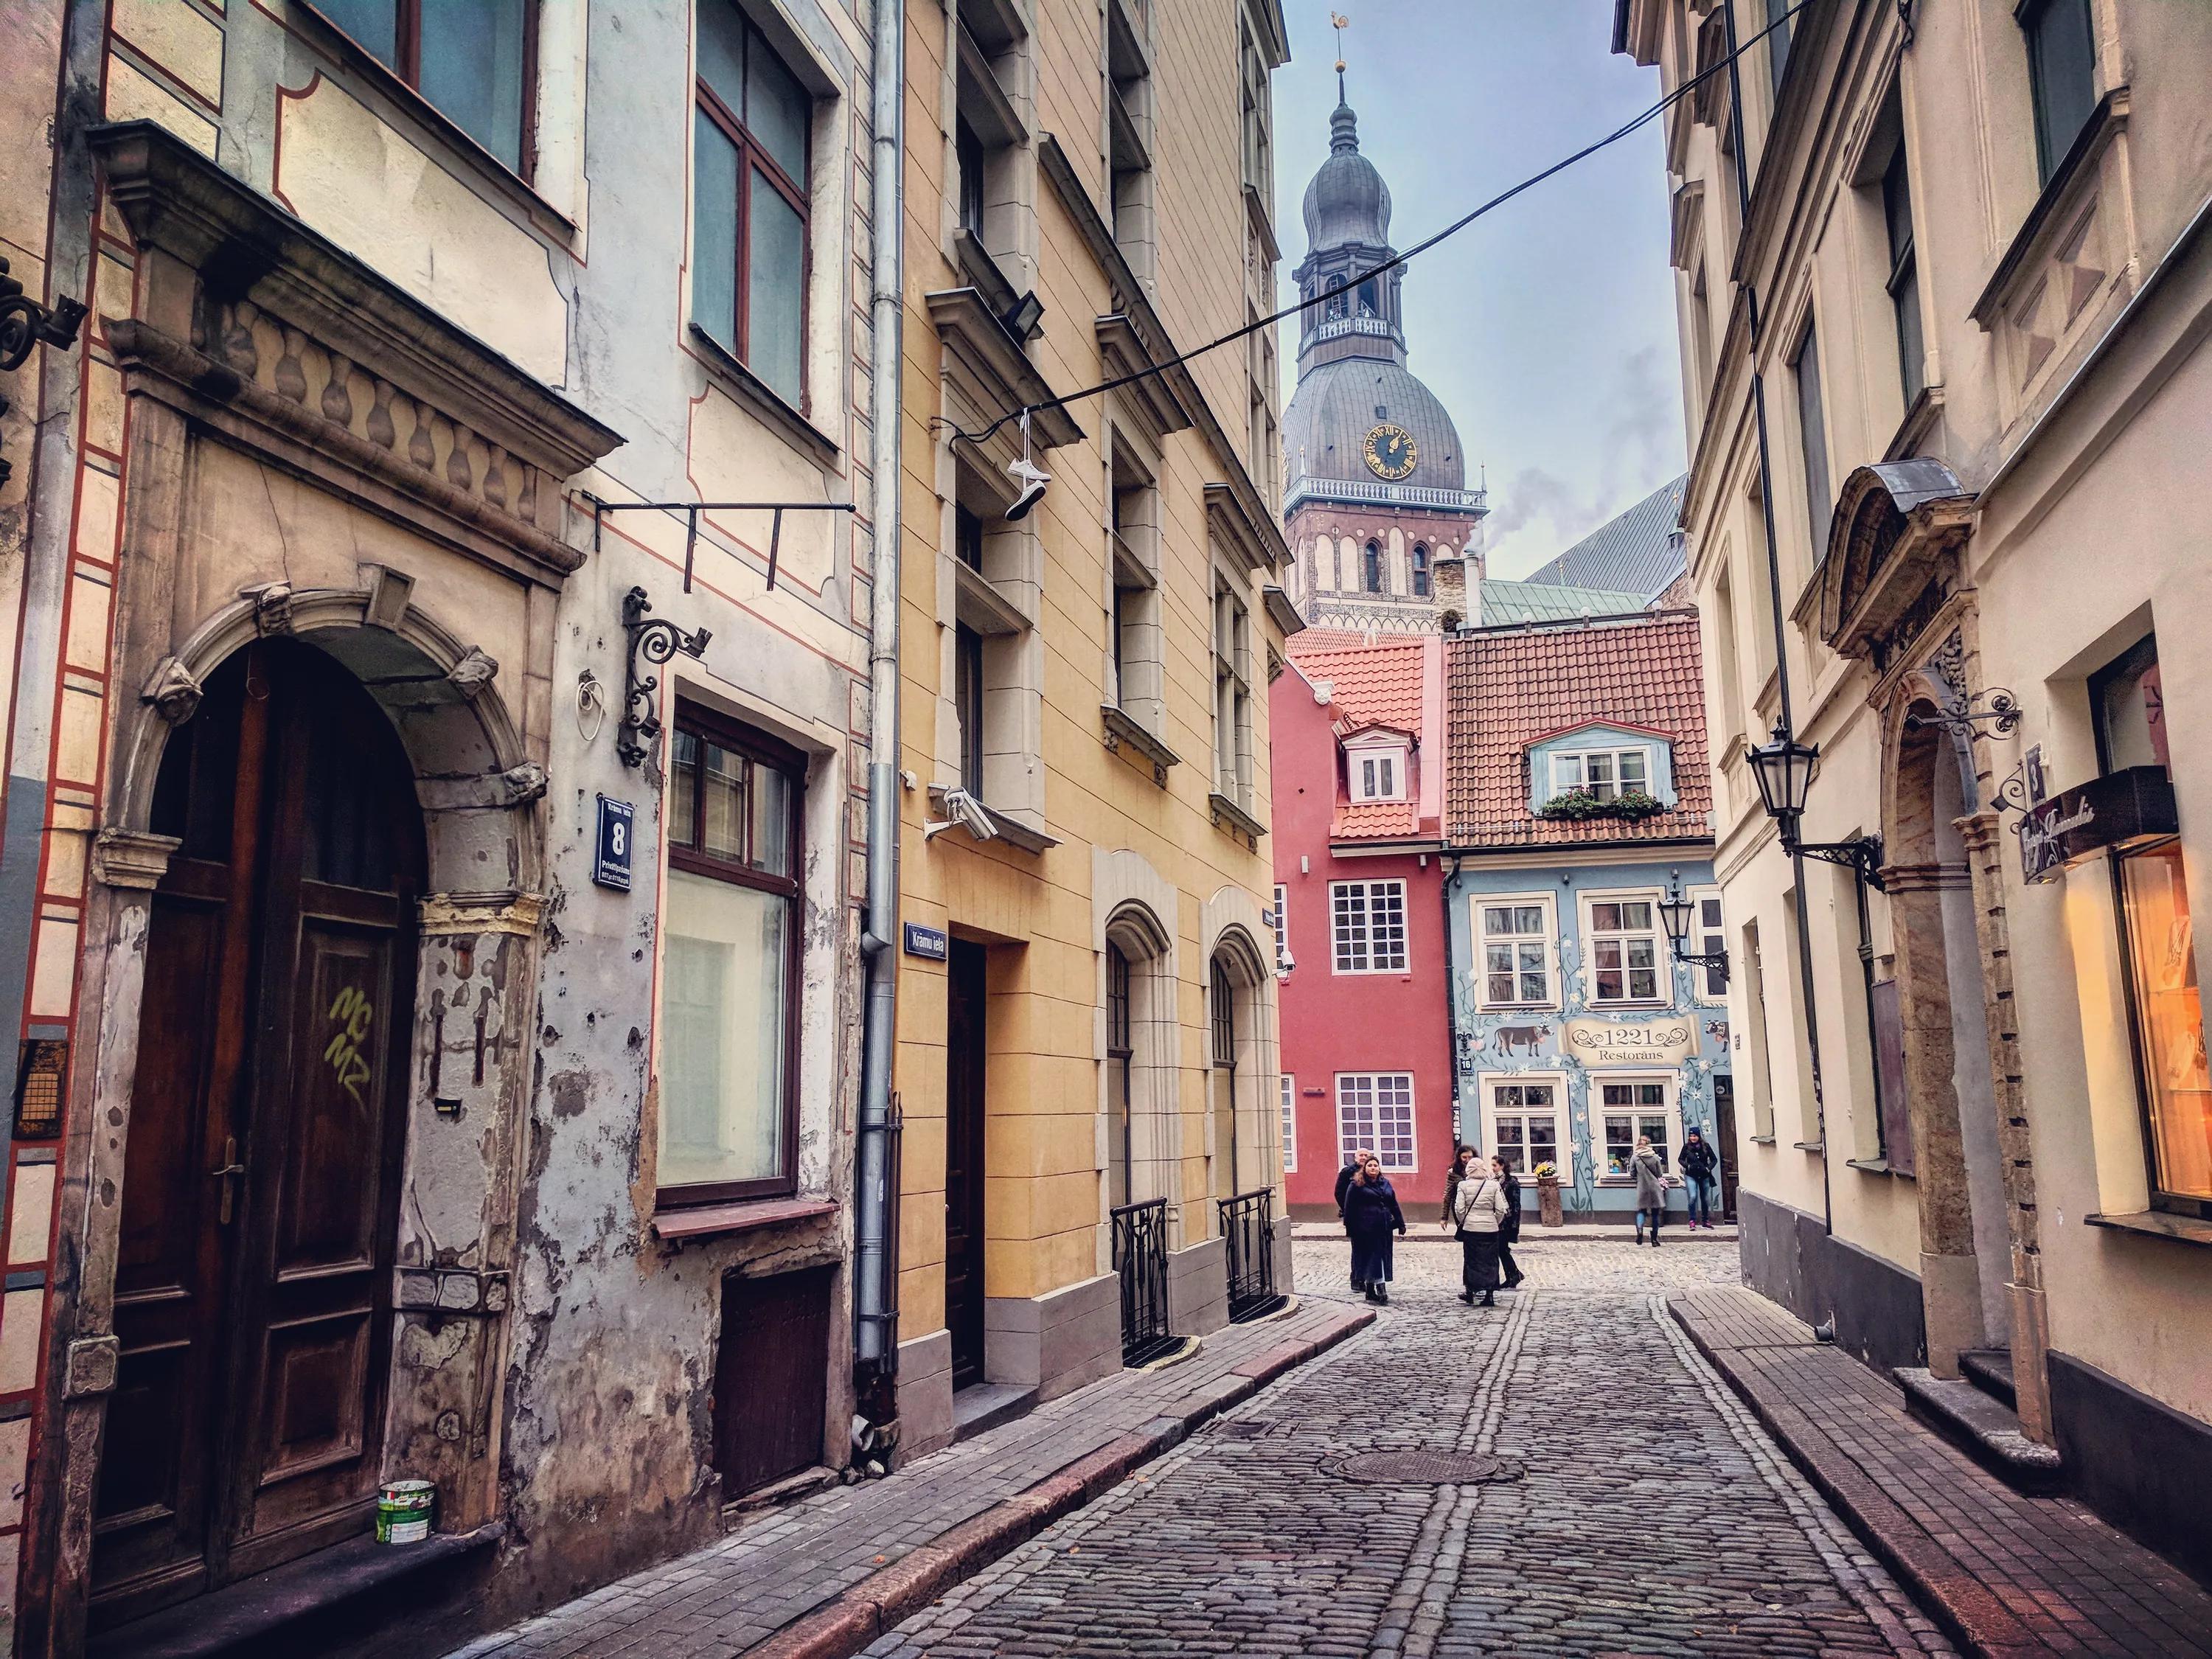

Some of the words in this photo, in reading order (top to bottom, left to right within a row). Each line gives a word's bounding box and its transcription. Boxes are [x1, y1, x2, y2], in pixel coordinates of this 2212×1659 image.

[2031, 764, 2039, 793] 3
[612, 822, 625, 855] 8
[912, 931, 933, 950] Krāmu
[933, 936, 944, 952] iela
[1604, 1029, 1654, 1046] 1221
[1461, 1060, 1471, 1069] 16
[1599, 1050, 1663, 1060] Restorāns
